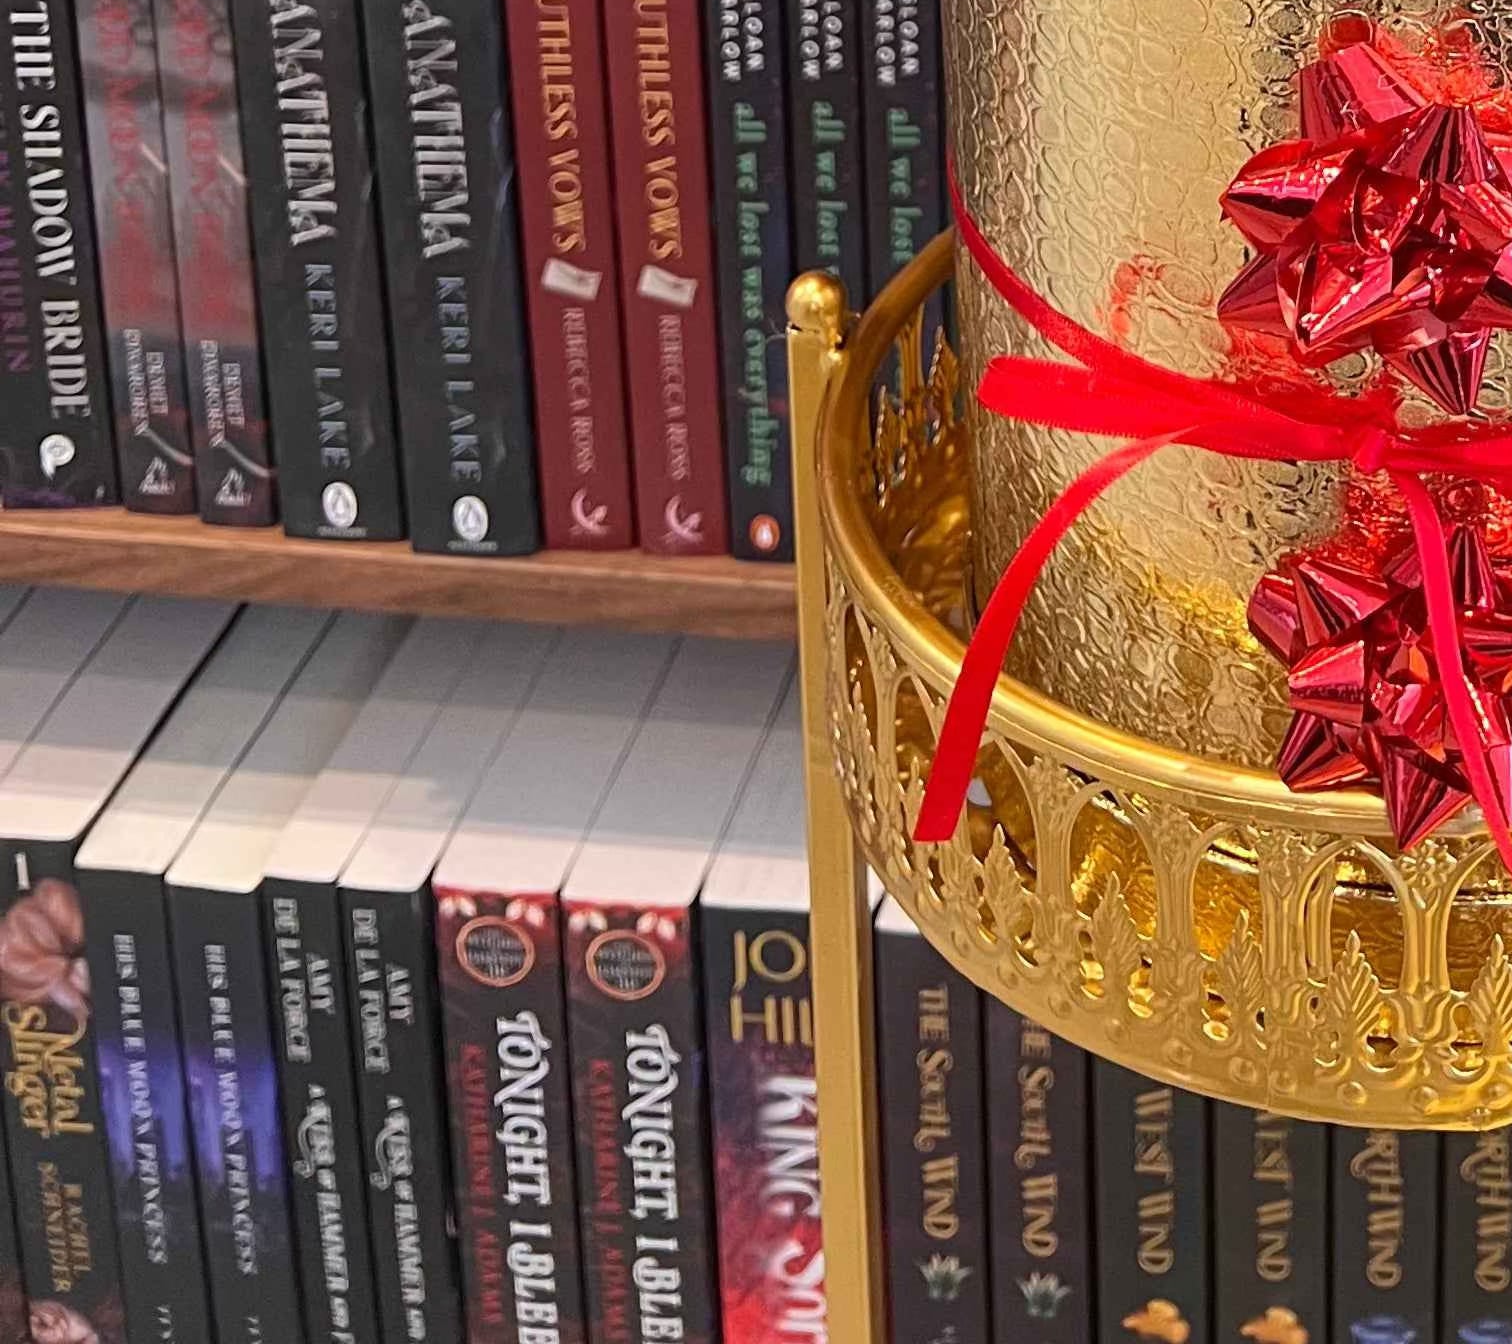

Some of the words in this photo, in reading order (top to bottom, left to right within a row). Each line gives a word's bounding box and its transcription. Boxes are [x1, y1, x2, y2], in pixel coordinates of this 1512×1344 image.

[12, 0, 57, 92] THE
[733, 101, 768, 144] all
[810, 100, 846, 144] all
[887, 107, 921, 147] all
[20, 103, 77, 286] SHADOW
[546, 148, 586, 254] VOWS
[644, 155, 684, 260] VOWS
[736, 152, 763, 191] we
[814, 151, 839, 192] we
[888, 154, 914, 196] we
[739, 199, 770, 259] lost
[816, 198, 848, 257] lost
[889, 205, 923, 264] lost
[303, 263, 340, 354] KERI
[433, 275, 473, 366] KERI
[741, 265, 766, 322] was
[40, 298, 92, 419] BRIDE
[312, 367, 351, 471] LAKE
[443, 378, 483, 484] LAKE
[738, 326, 781, 488] everything
[273, 897, 299, 936] DE
[352, 909, 380, 945] DE
[276, 938, 301, 974] LA
[306, 953, 335, 1015] AMY
[355, 949, 382, 984] LA
[385, 962, 416, 1025] AMY
[280, 978, 312, 1064] FORCE
[359, 990, 392, 1075] FORCE
[127, 1060, 156, 1138] MOON
[217, 1071, 243, 1148] MOON
[494, 1011, 552, 1208] TONIGHT,
[622, 1024, 681, 1222] TONIGHT,
[136, 1143, 169, 1265] PRINCESS
[225, 1153, 260, 1276] PRINCESS
[509, 1221, 552, 1238] I
[1137, 1189, 1176, 1275] WIND
[1256, 1199, 1294, 1282] WIND
[635, 1236, 679, 1254] I
